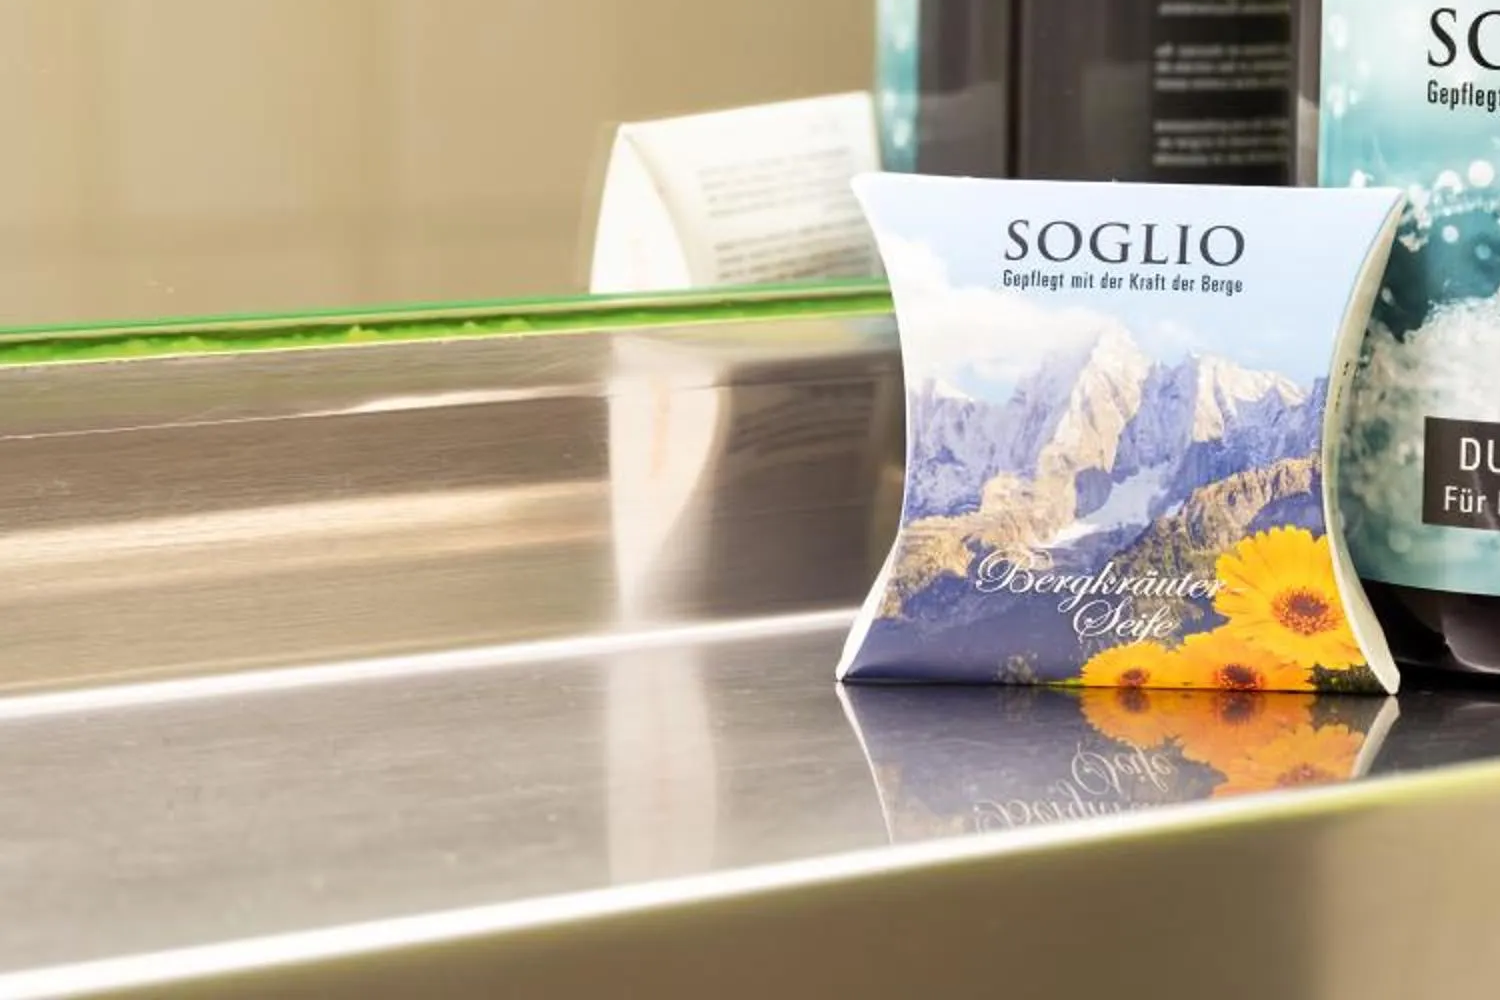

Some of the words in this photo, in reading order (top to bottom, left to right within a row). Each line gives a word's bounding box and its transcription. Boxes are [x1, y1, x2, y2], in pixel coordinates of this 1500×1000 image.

[1004, 219, 1245, 267] SOGLIO
[1003, 269, 1064, 291] Gepflegt
[1071, 271, 1094, 289] mit
[1100, 272, 1124, 290] der
[1129, 273, 1166, 291] Kraft
[1172, 274, 1196, 292] der
[1201, 275, 1244, 297] Berge
[1444, 485, 1487, 513] Für
[1073, 598, 1176, 643] Seife
